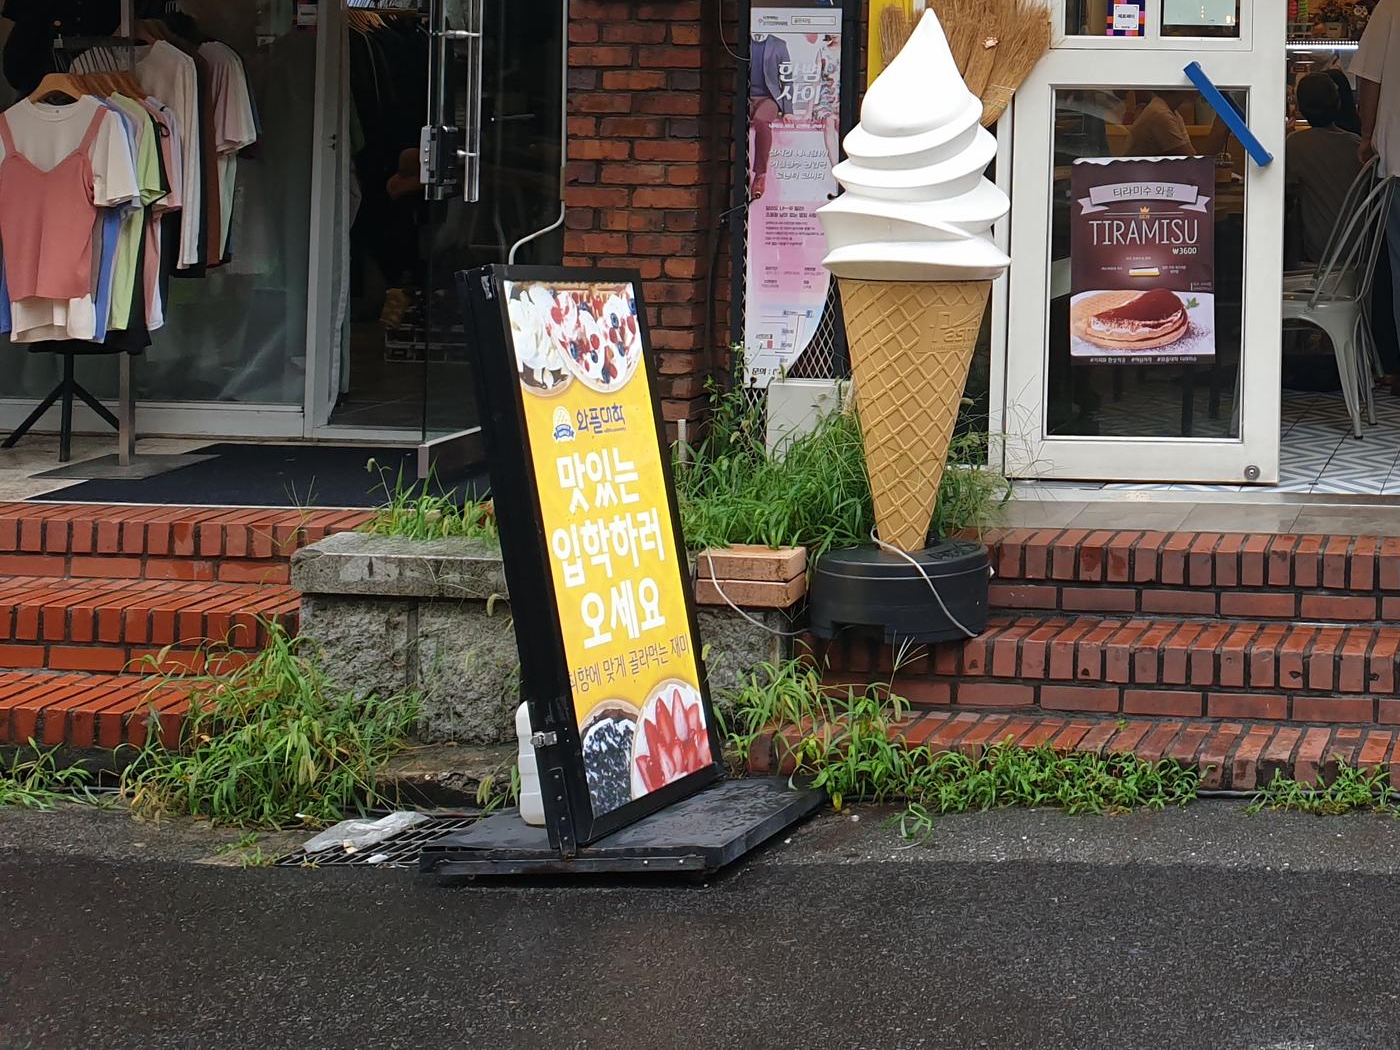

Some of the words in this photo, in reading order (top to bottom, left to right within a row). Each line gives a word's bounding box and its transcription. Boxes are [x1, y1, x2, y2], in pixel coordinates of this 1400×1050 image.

[1113, 186, 1151, 197] 티라미수
[1155, 186, 1175, 198] 와플
[1089, 219, 1198, 246] TIRAMISU
[577, 402, 625, 434] 와플대학
[556, 447, 640, 514] 맛있는
[552, 507, 665, 588] 입학하러
[580, 577, 666, 649] 오세요
[602, 654, 627, 681] 맞게
[628, 644, 669, 675] 골라먹는
[670, 634, 689, 656] 재미
